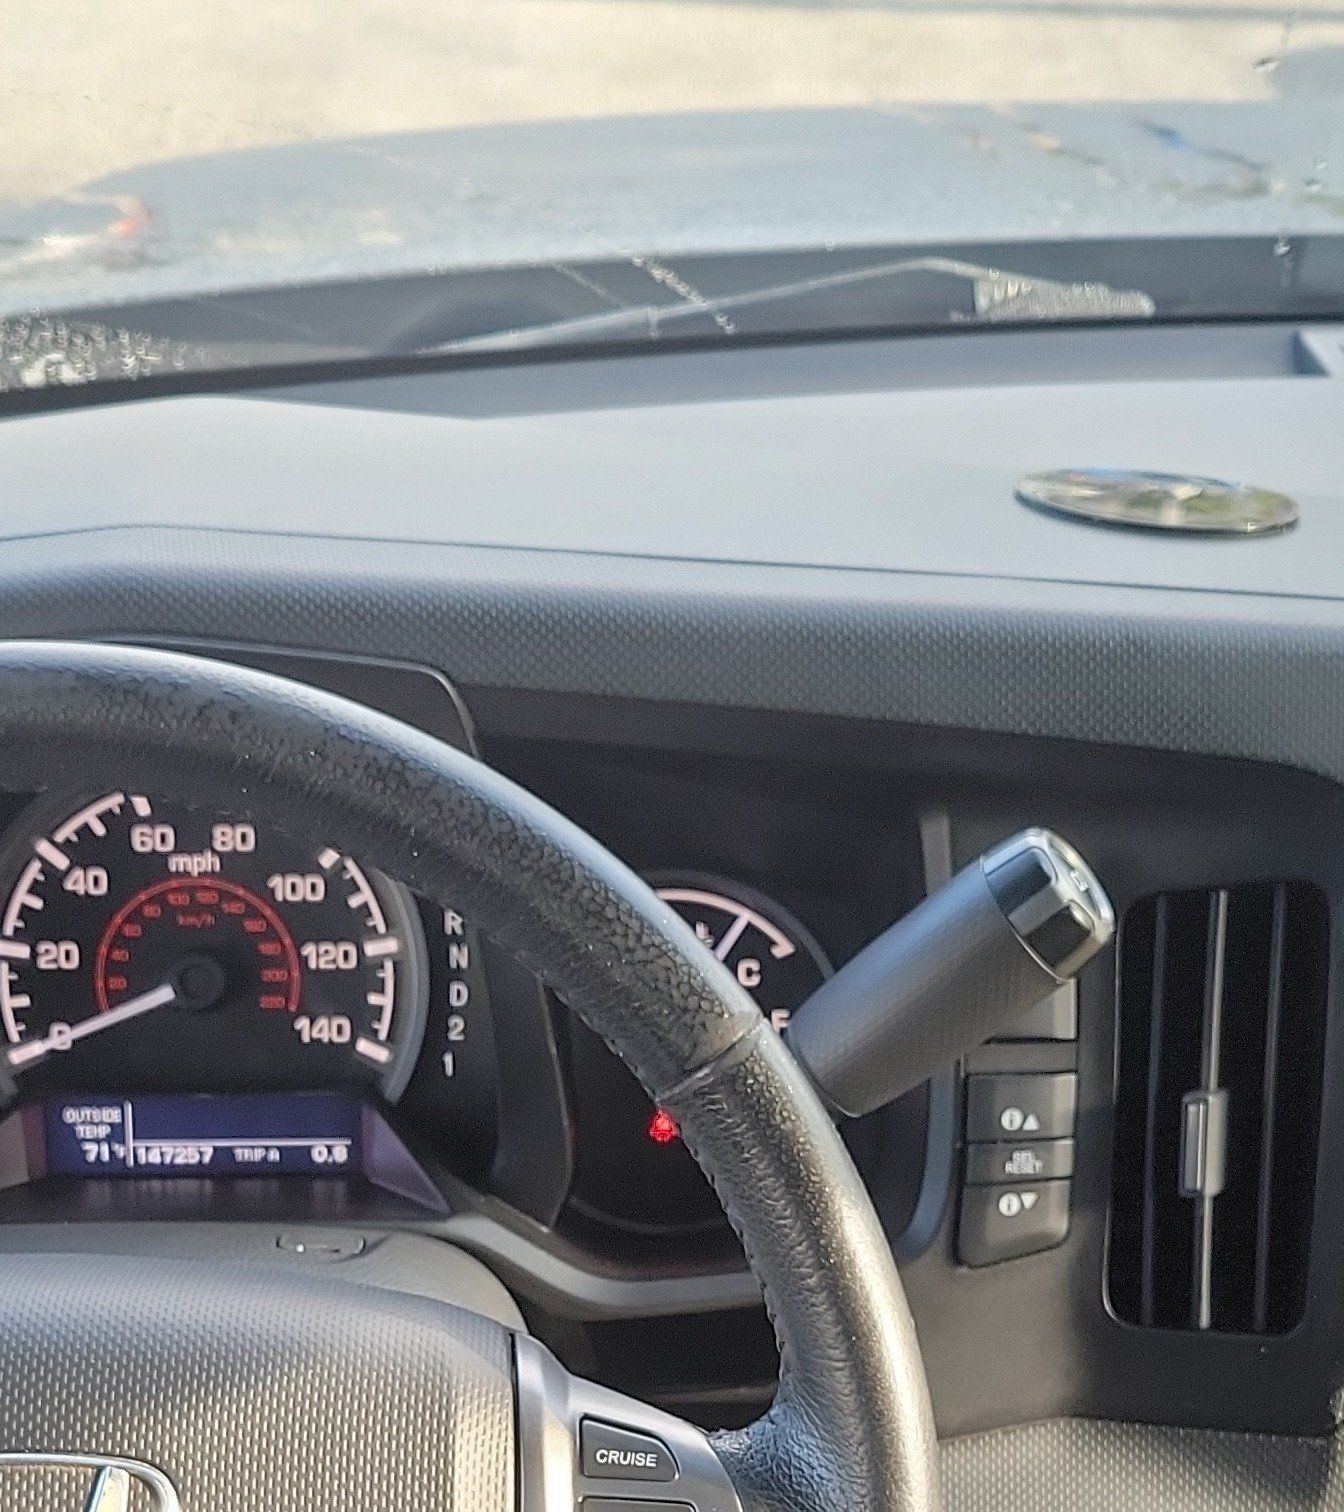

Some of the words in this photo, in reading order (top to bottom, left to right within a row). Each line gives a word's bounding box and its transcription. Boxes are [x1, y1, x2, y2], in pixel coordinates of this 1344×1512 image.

[130, 824, 175, 853] 60
[211, 823, 256, 852] 80
[167, 849, 221, 877] mph
[62, 866, 108, 895] 40
[266, 873, 325, 902] 100
[443, 908, 464, 935] R
[36, 940, 80, 970] 20
[300, 940, 357, 970] 120
[449, 942, 469, 970] N
[737, 957, 761, 987] C
[449, 979, 469, 1007] D
[293, 1015, 352, 1044] 140
[447, 1014, 466, 1041] 2
[442, 1050, 454, 1077] 1
[62, 1106, 122, 1123] OUTSIDE
[74, 1124, 111, 1139] TEMP
[595, 1448, 658, 1467] CRUISE
